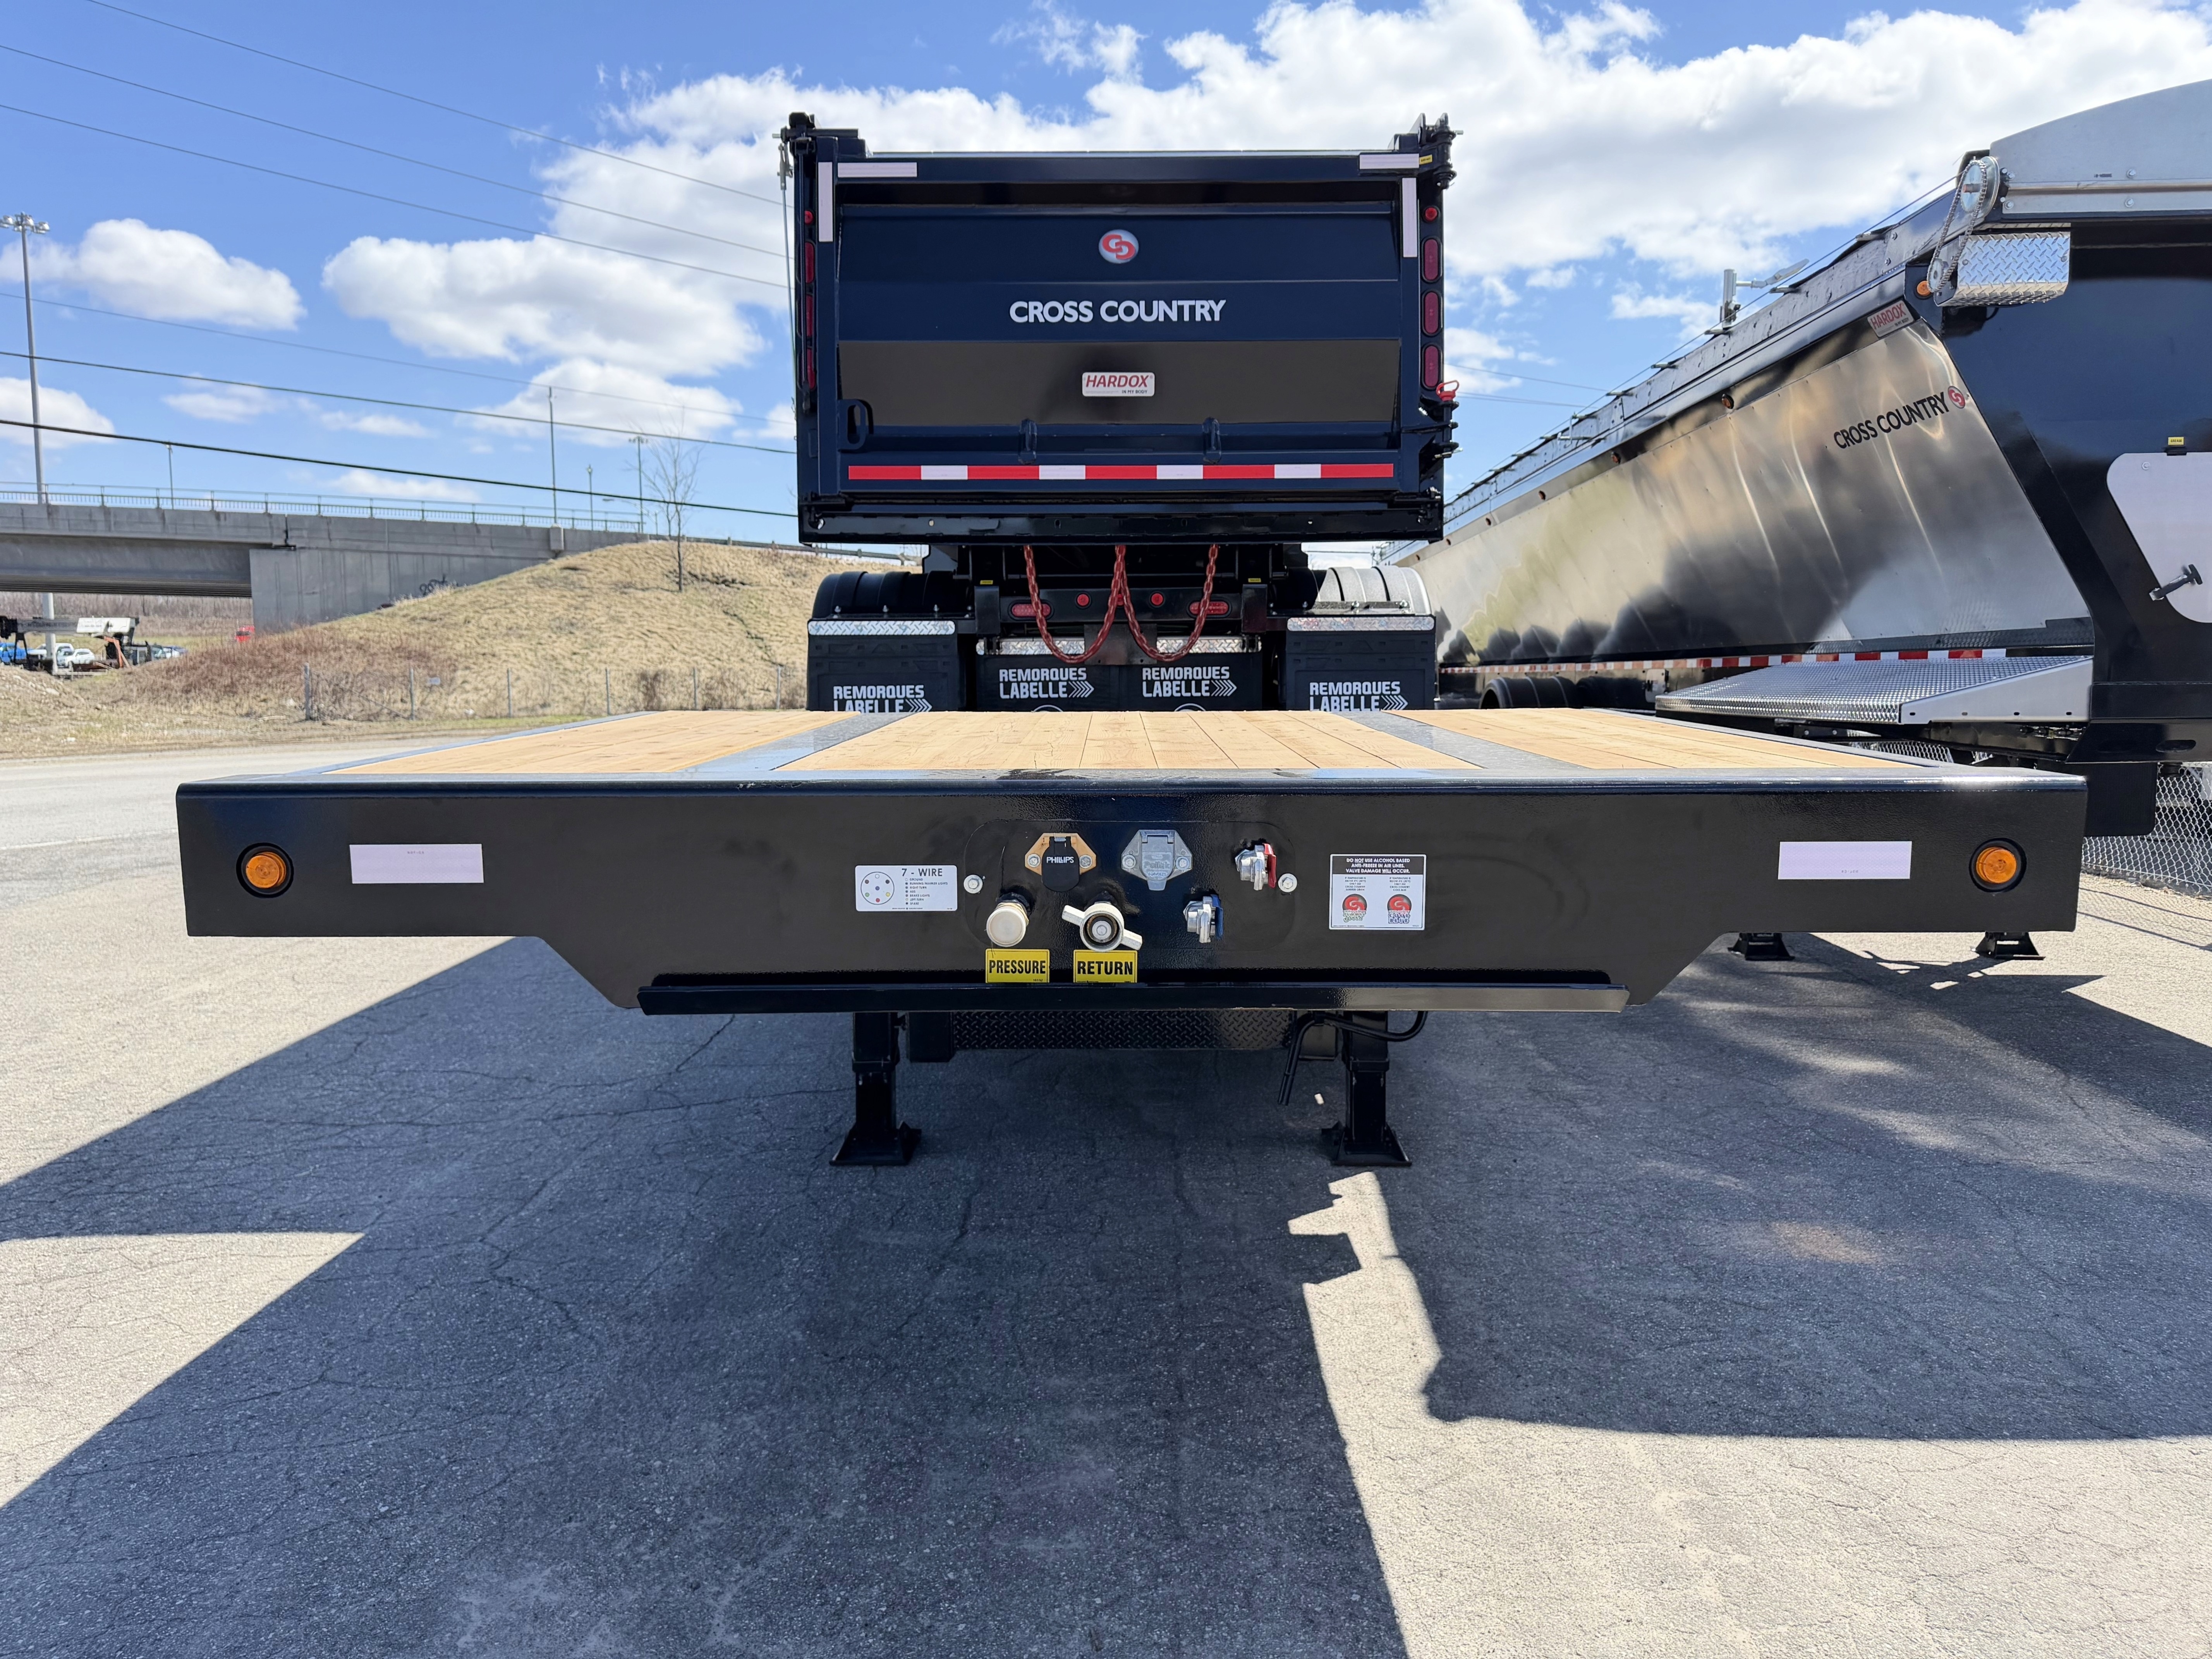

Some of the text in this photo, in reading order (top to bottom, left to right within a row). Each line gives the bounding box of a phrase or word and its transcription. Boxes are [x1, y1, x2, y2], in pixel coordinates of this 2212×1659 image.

[1010, 300, 1226, 323] CROSS COUNTRY
[1870, 303, 1906, 330] HARDOX
[1086, 375, 1149, 388] HARDOX
[1834, 392, 1949, 449] CROSS COUNTRY
[999, 668, 1087, 682] REMORQUES
[1142, 666, 1230, 680] REMORQUES
[833, 685, 924, 699] REMORQUES
[999, 681, 1067, 699] LABELLE
[1142, 680, 1210, 697] LABELLE
[1310, 681, 1400, 696] REMORQUES
[833, 699, 904, 713] LABELLE
[1310, 696, 1380, 712] LABELLE
[902, 868, 907, 876] 7
[918, 868, 943, 876] WIRE
[989, 960, 1046, 974] PRESSURE
[1077, 961, 1133, 975] RETURN
